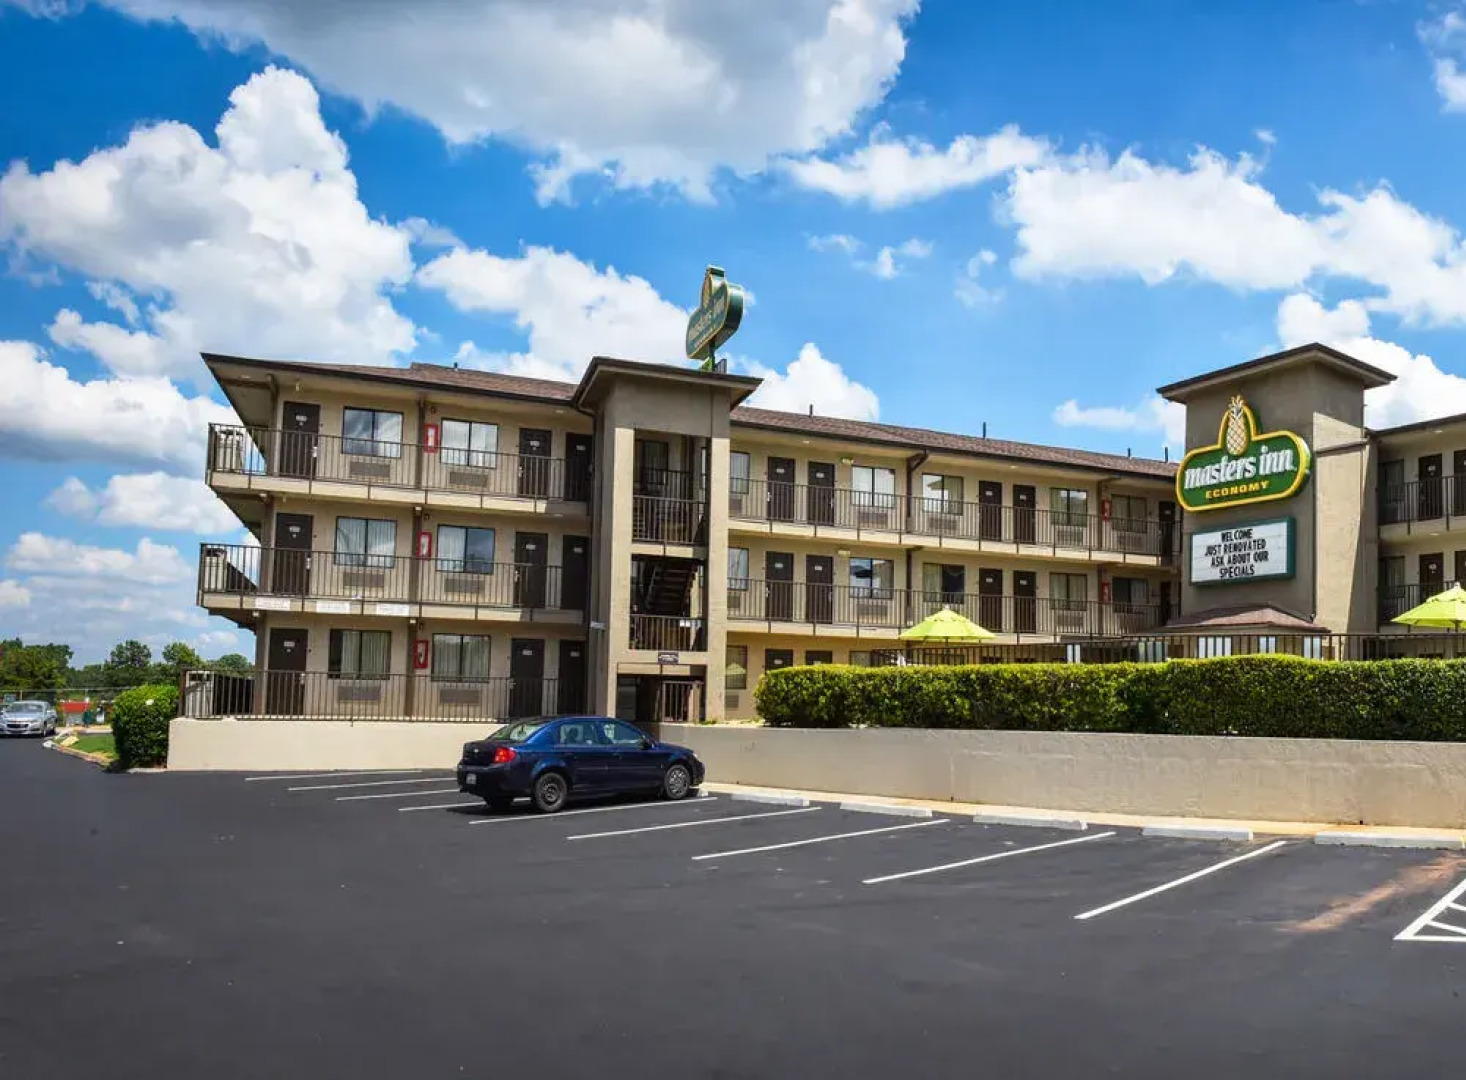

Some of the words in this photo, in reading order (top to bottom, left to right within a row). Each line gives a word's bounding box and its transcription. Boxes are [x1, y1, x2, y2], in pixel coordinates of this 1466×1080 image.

[1184, 455, 1257, 489] masters
[1259, 445, 1294, 476] inn
[1205, 480, 1270, 499] ECONOMY
[1221, 528, 1254, 543] WELCOME
[1204, 544, 1222, 557] JUST
[1223, 538, 1267, 554] RENOVATED
[1211, 555, 1225, 568] ASK
[1227, 552, 1251, 565] ABOUT
[1253, 550, 1269, 563] OUR
[1219, 564, 1255, 578] SPECIALS
